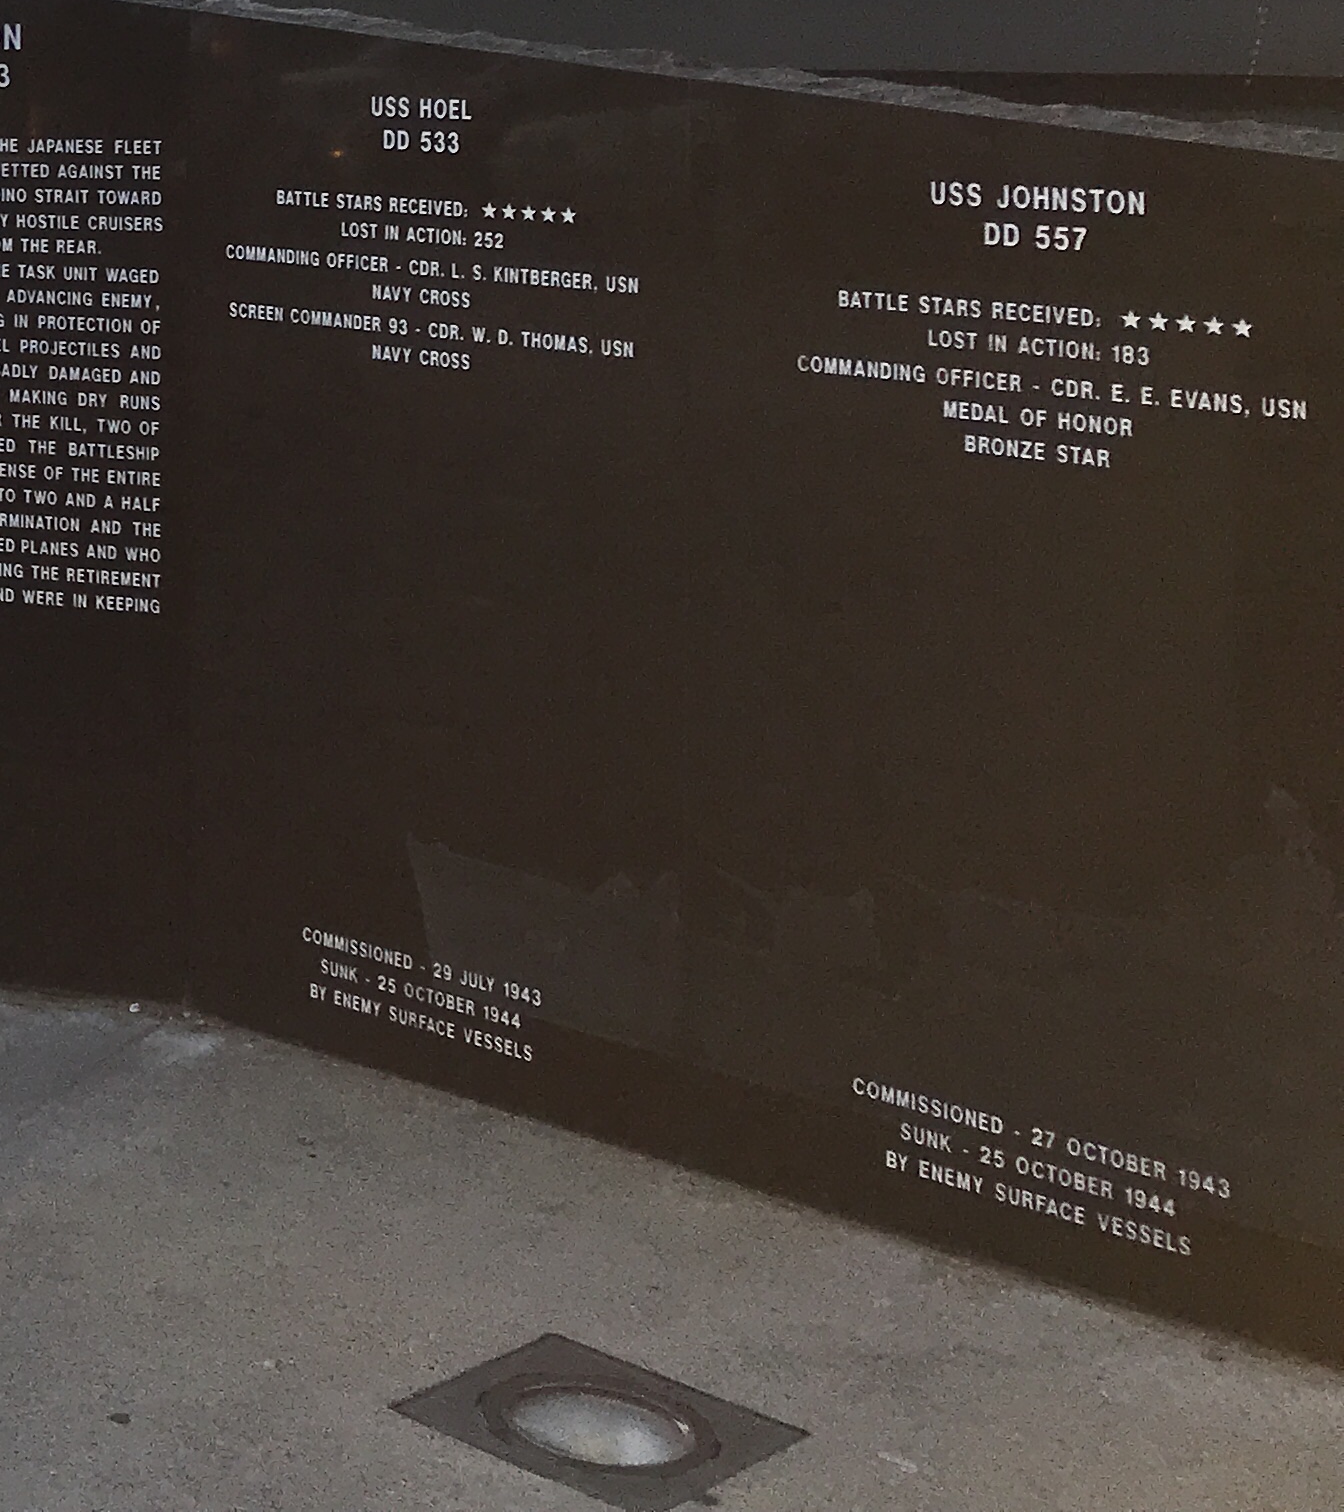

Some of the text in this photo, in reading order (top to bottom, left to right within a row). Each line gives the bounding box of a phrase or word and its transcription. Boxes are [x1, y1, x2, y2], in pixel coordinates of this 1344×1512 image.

[371, 95, 472, 120] USS HOEL
[27, 138, 103, 154] JAPANESE
[114, 139, 162, 155] FLEET
[383, 129, 460, 154] DD 533
[276, 189, 468, 218] BATTLE STARS RECEIVED:
[930, 181, 1145, 216] USS JOHNSTON
[341, 221, 504, 249] LOST IN ACTION: 252
[984, 222, 1087, 251] DD 557
[838, 289, 1101, 328] BATTLE STARS RECEIVED:
[928, 329, 1150, 366] LOST IN ACTION: 183
[943, 400, 1133, 437] MEDAL OF HONOR
[964, 434, 1111, 468] BRONZE STAR
[310, 983, 533, 1062] BY ENEMY SURFACE VESSELS
